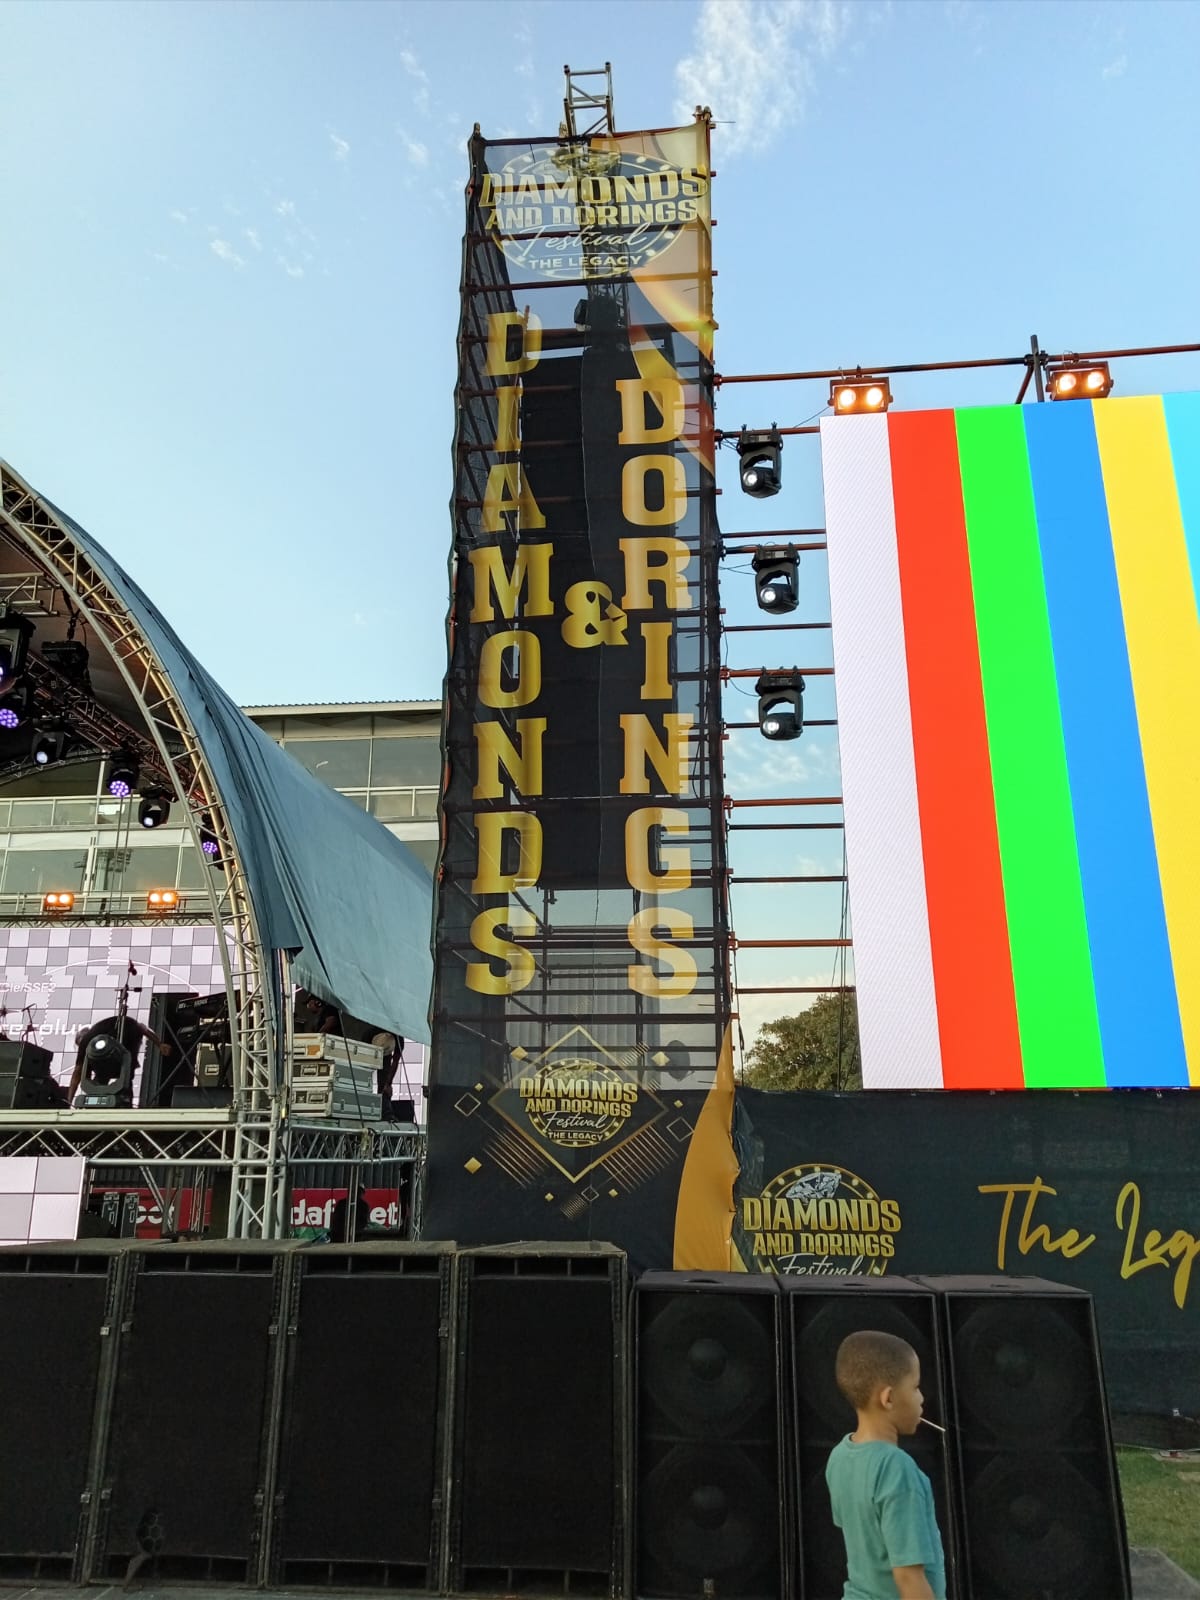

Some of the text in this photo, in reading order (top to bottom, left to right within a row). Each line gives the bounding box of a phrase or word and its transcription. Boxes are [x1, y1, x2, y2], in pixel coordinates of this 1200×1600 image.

[478, 166, 708, 207] DIAMONDS
[485, 199, 699, 230] AND DORINGS
[519, 223, 651, 257] Festival
[529, 255, 642, 270] THE LEGACY
[561, 581, 628, 648] &
[465, 311, 554, 995] DIAMONDS
[616, 378, 697, 1000] DORINGS
[520, 1077, 638, 1103] DIAMONDS
[525, 1098, 632, 1118] AND DORINGS
[543, 1110, 608, 1130] Festival
[548, 1131, 603, 1141] THE LEGACY
[742, 1197, 901, 1232] DIAMONDS
[978, 1176, 1096, 1270] The
[752, 1233, 895, 1257] AND DORINGS
[777, 1253, 863, 1276] Festival
